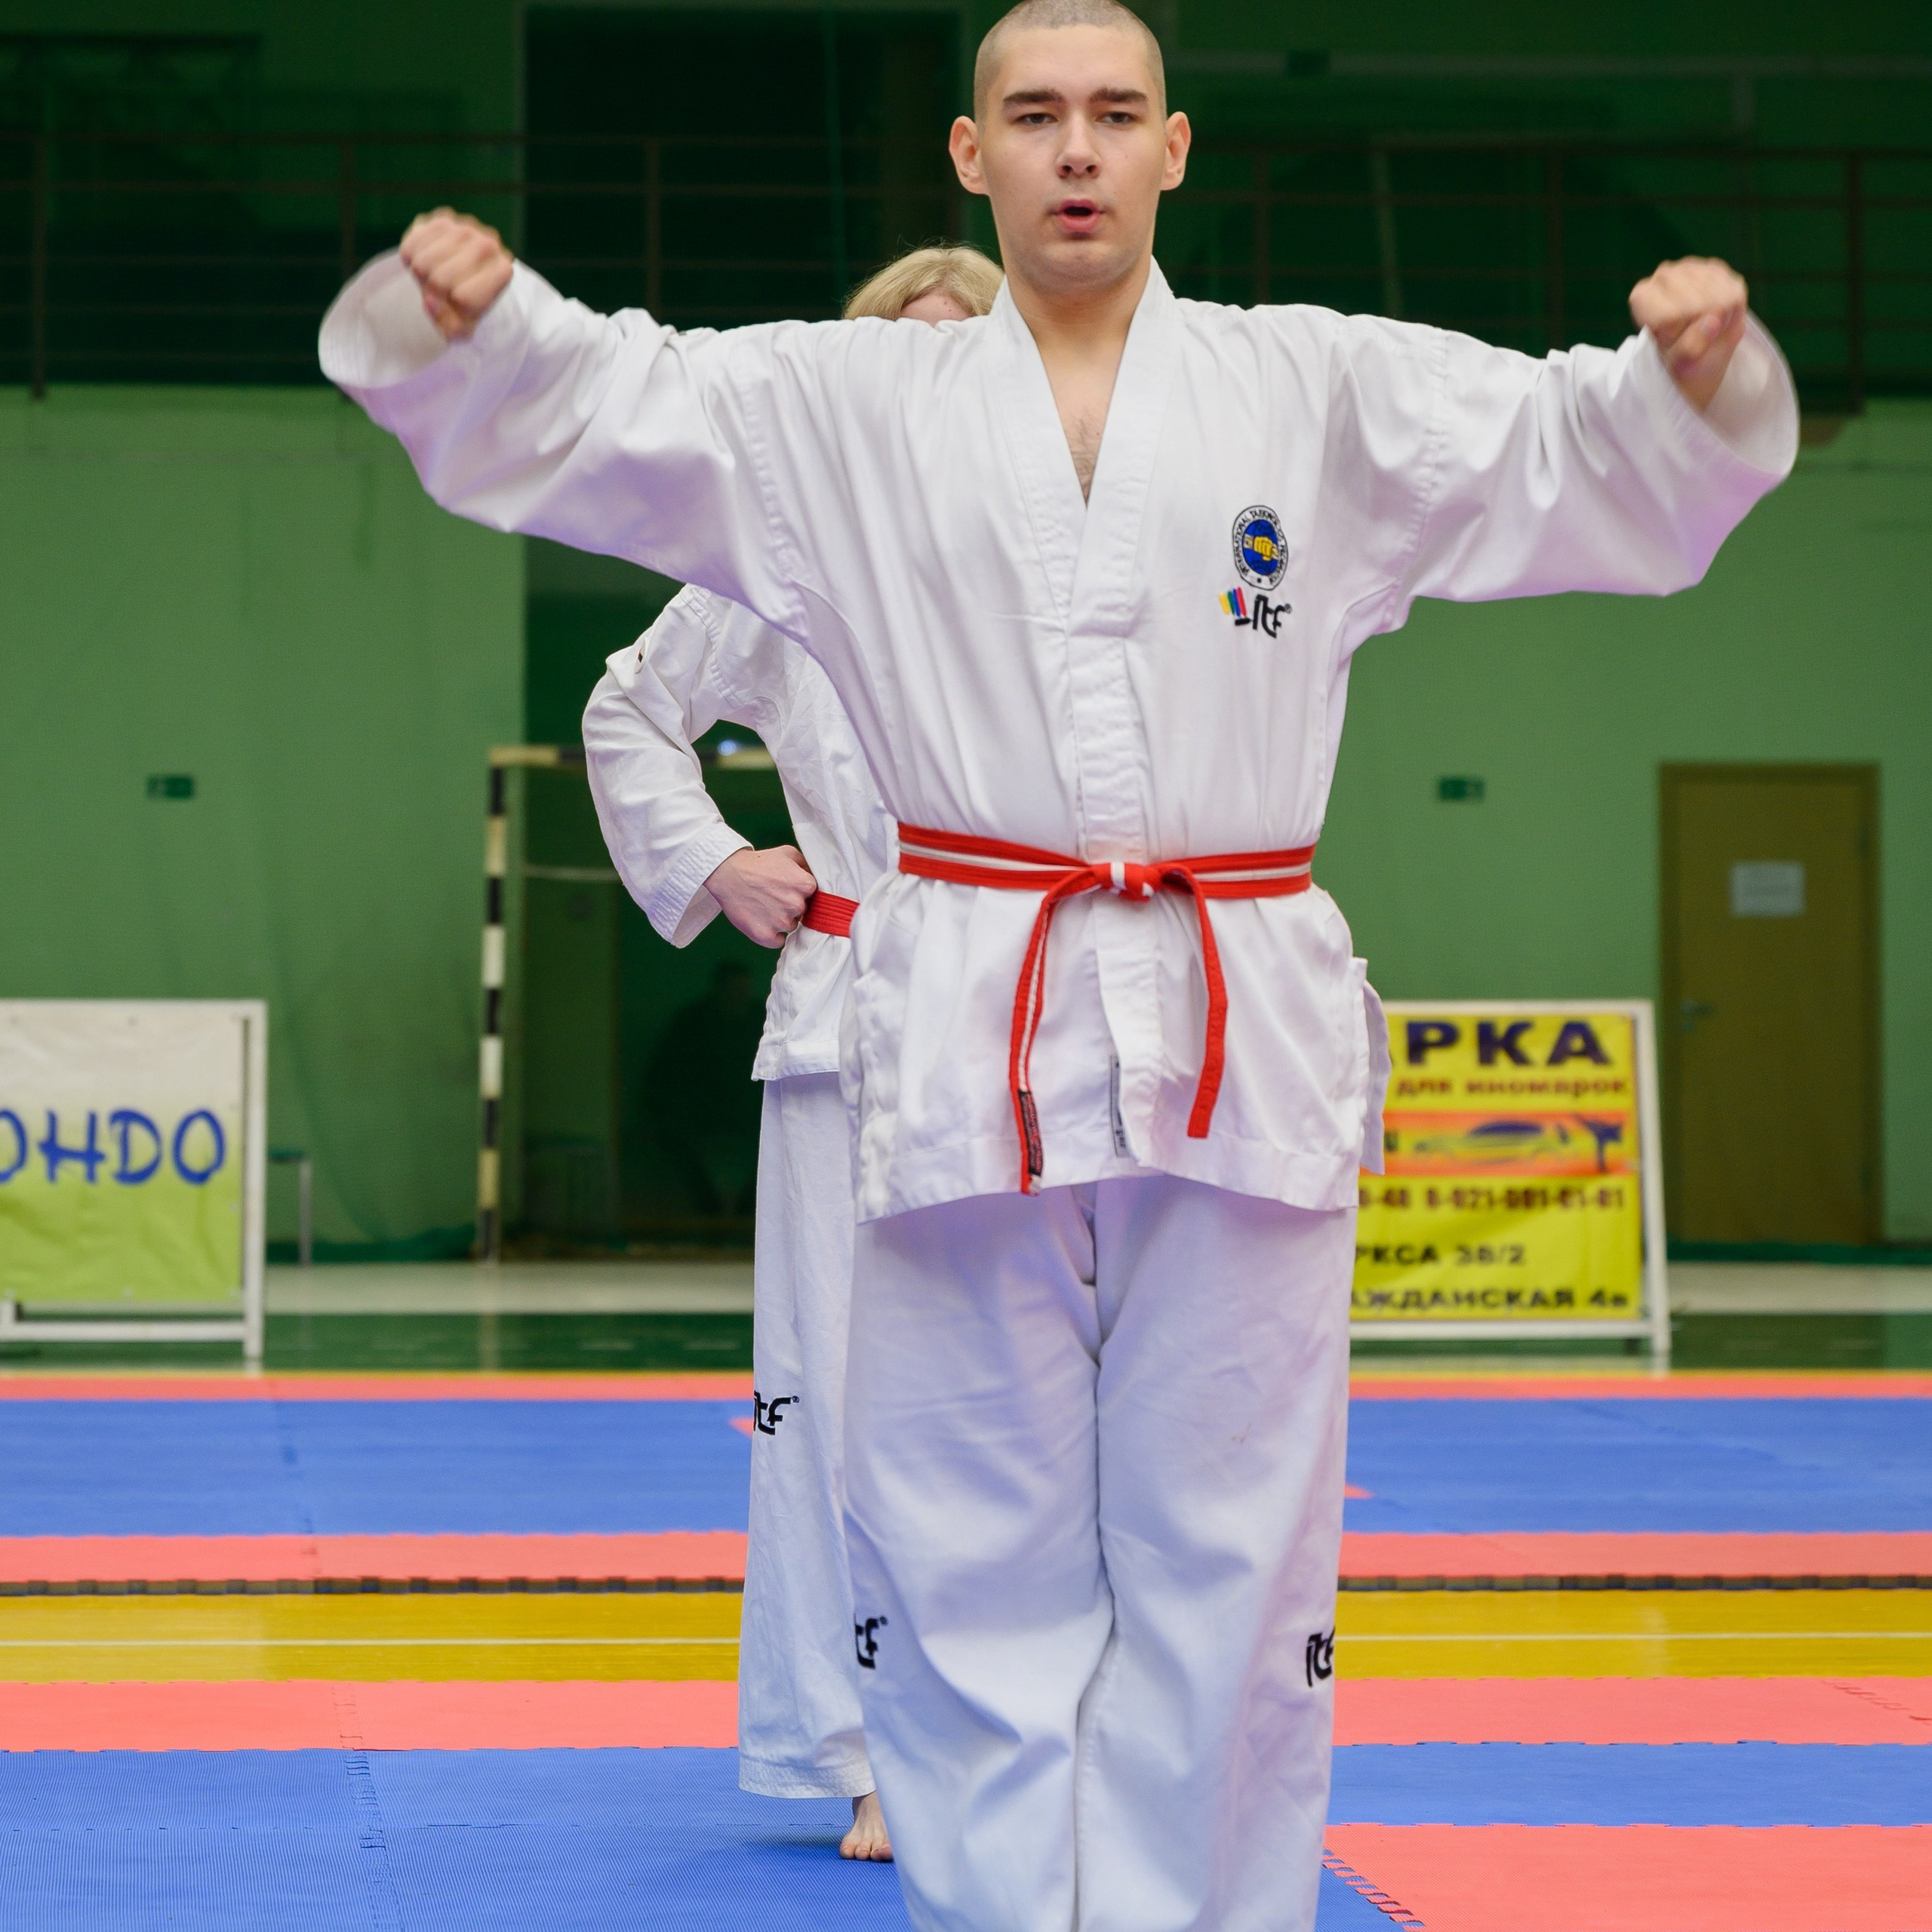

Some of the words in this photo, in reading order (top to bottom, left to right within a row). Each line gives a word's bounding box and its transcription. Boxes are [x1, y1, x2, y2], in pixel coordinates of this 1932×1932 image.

[1391, 1020, 1611, 1066] РКА
[1395, 1078, 1451, 1097] для
[1466, 1078, 1626, 1098] иномарок
